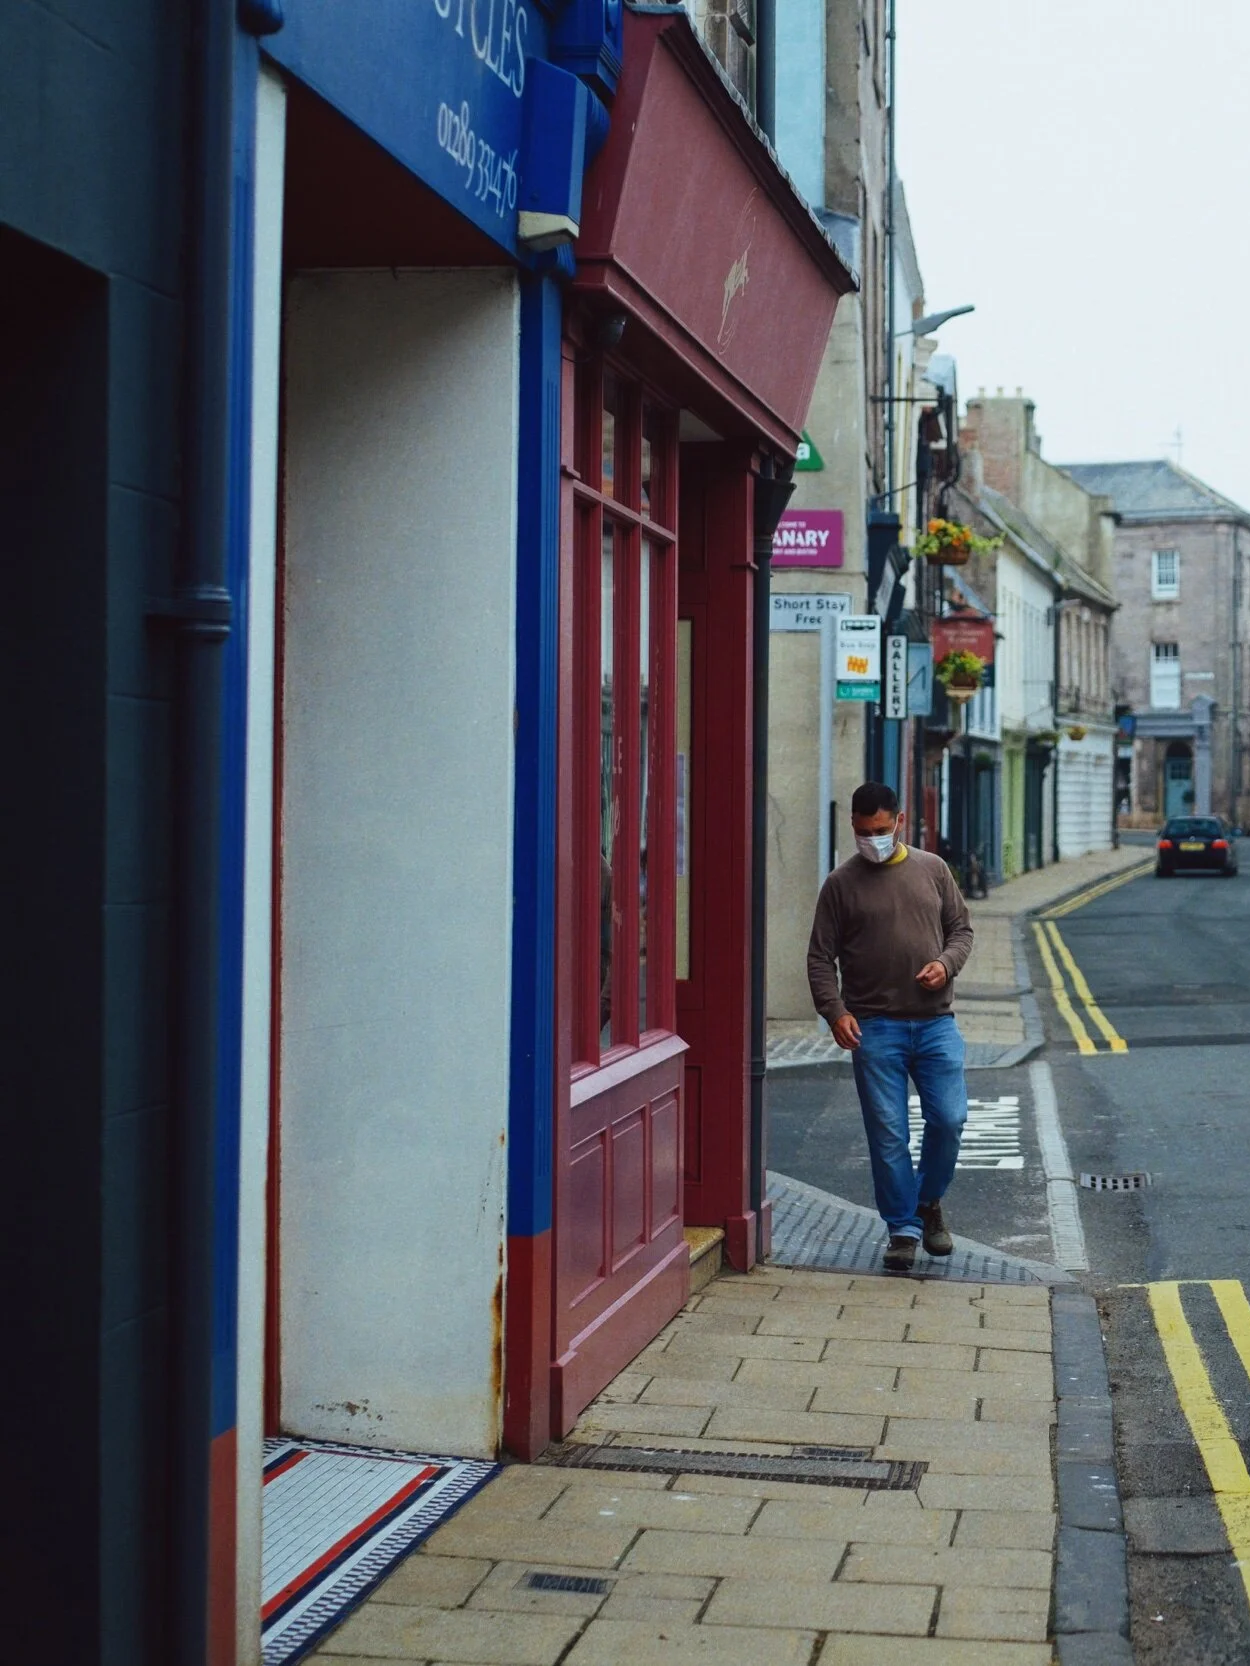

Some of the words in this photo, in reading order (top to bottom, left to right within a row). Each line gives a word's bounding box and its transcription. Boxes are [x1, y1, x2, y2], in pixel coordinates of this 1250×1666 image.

[437, 101, 476, 190] 01289
[475, 139, 518, 218] 331476
[772, 530, 829, 548] ANARY
[774, 598, 810, 610] Short
[816, 598, 847, 613] Stay
[892, 638, 902, 716] GALLERY
